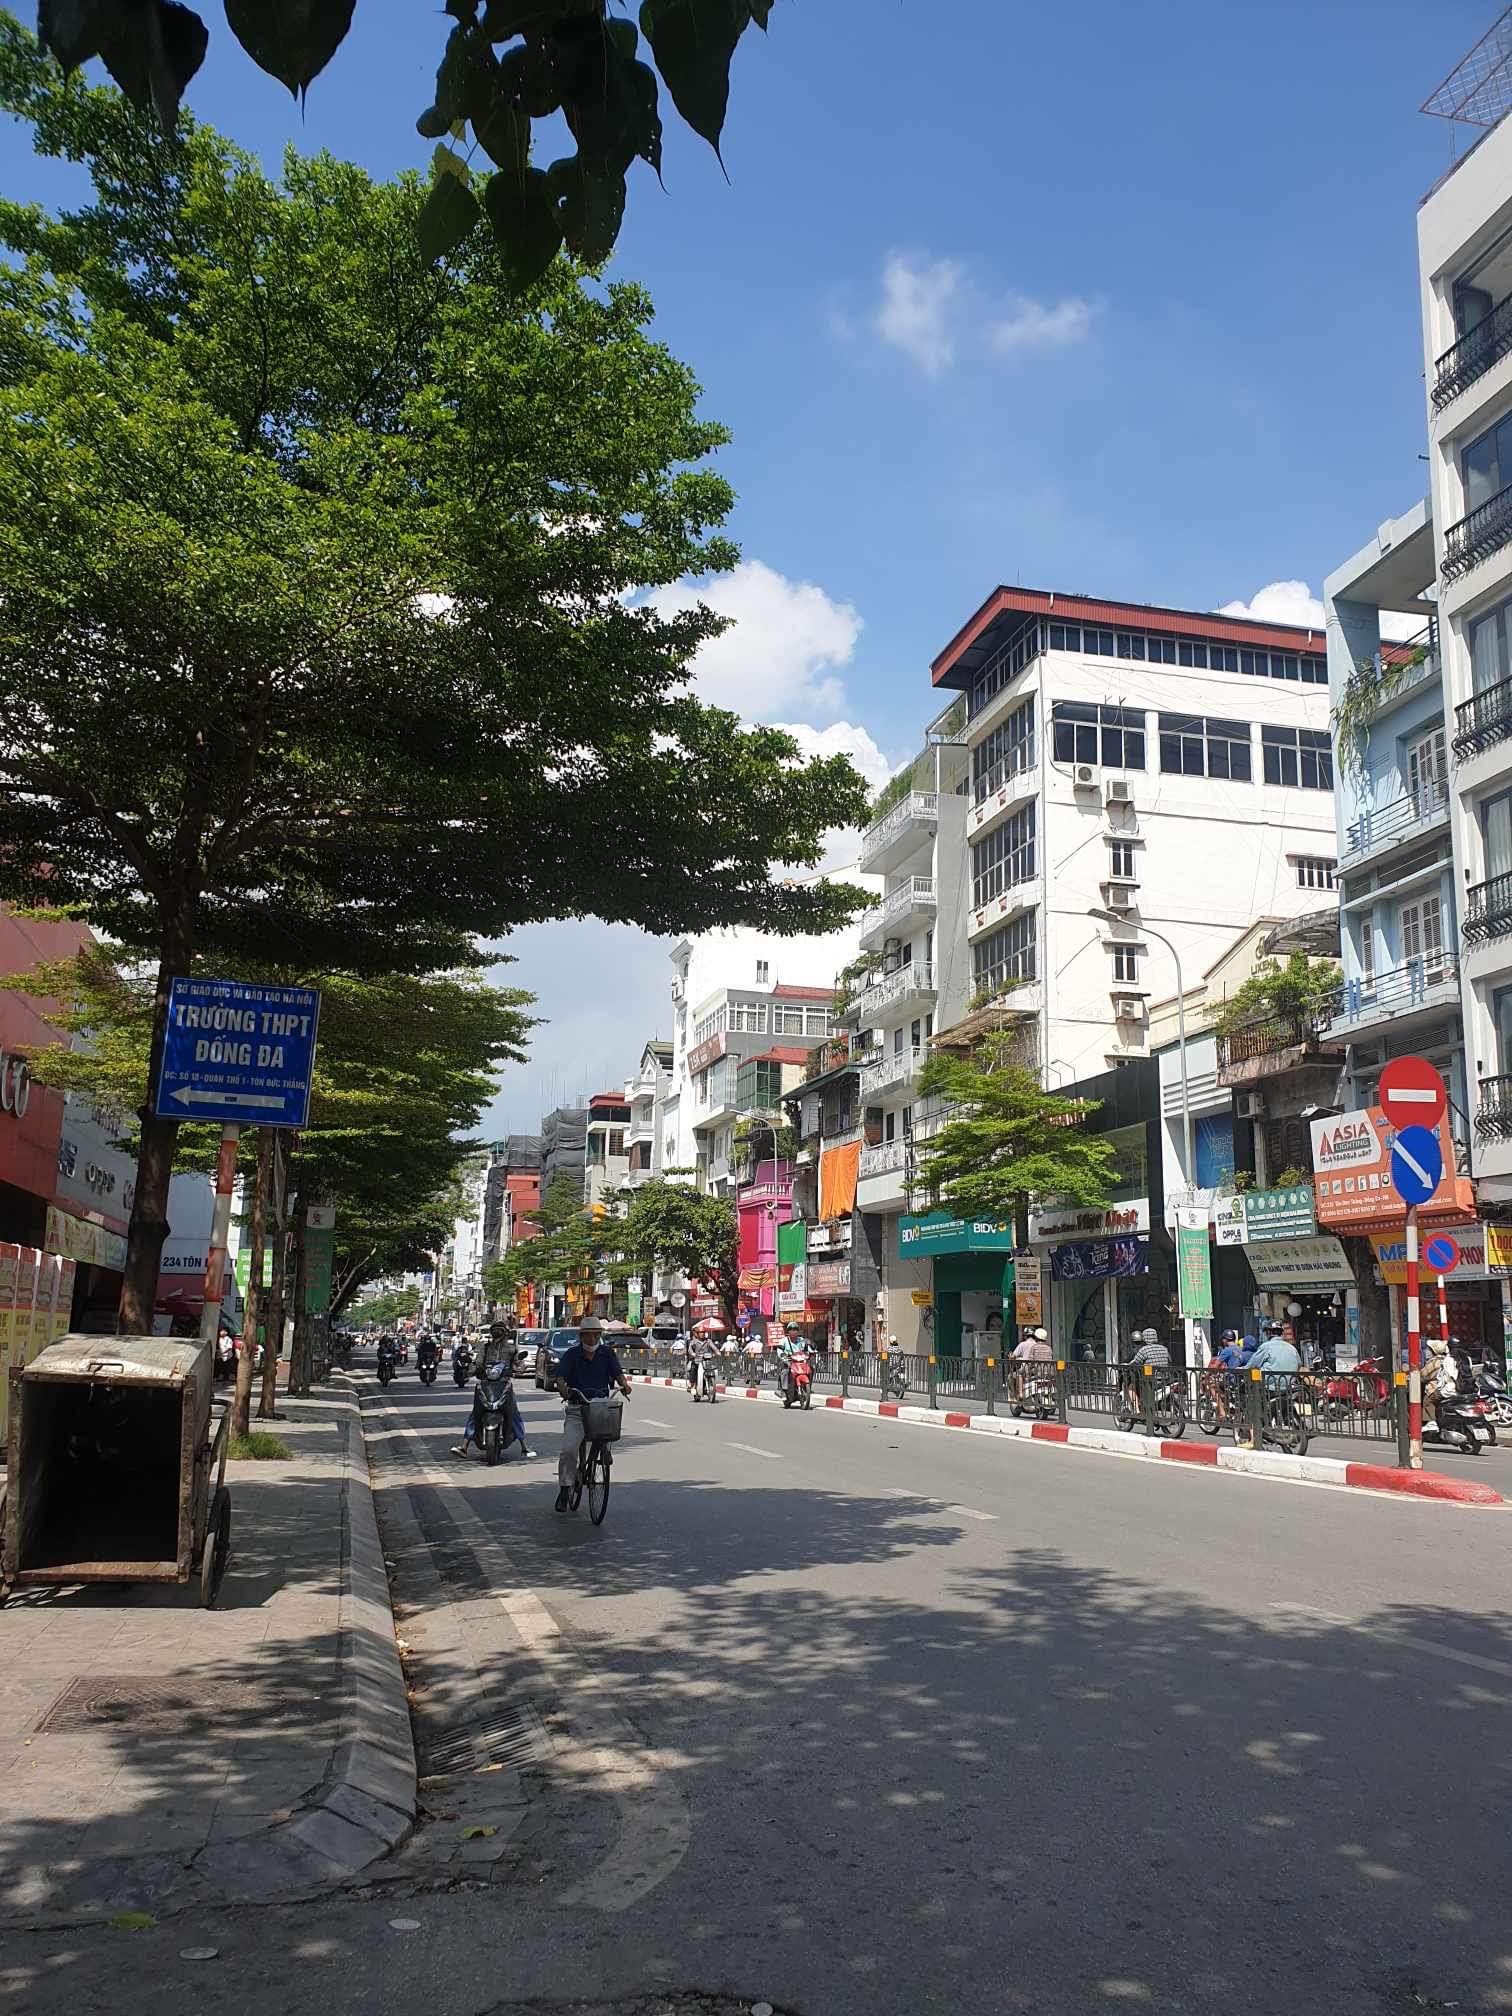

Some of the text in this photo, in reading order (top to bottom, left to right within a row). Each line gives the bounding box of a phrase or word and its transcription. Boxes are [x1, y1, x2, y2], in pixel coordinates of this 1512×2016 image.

[175, 1002, 311, 1037] TRƯỜNG THPT
[195, 1034, 284, 1068] ĐỐNG ĐA
[1333, 1121, 1370, 1142] ASIA
[1335, 1138, 1370, 1152] LIGHTING
[973, 1222, 997, 1233] BIDV
[163, 1257, 181, 1267] 234
[183, 1255, 201, 1268] TÔN
